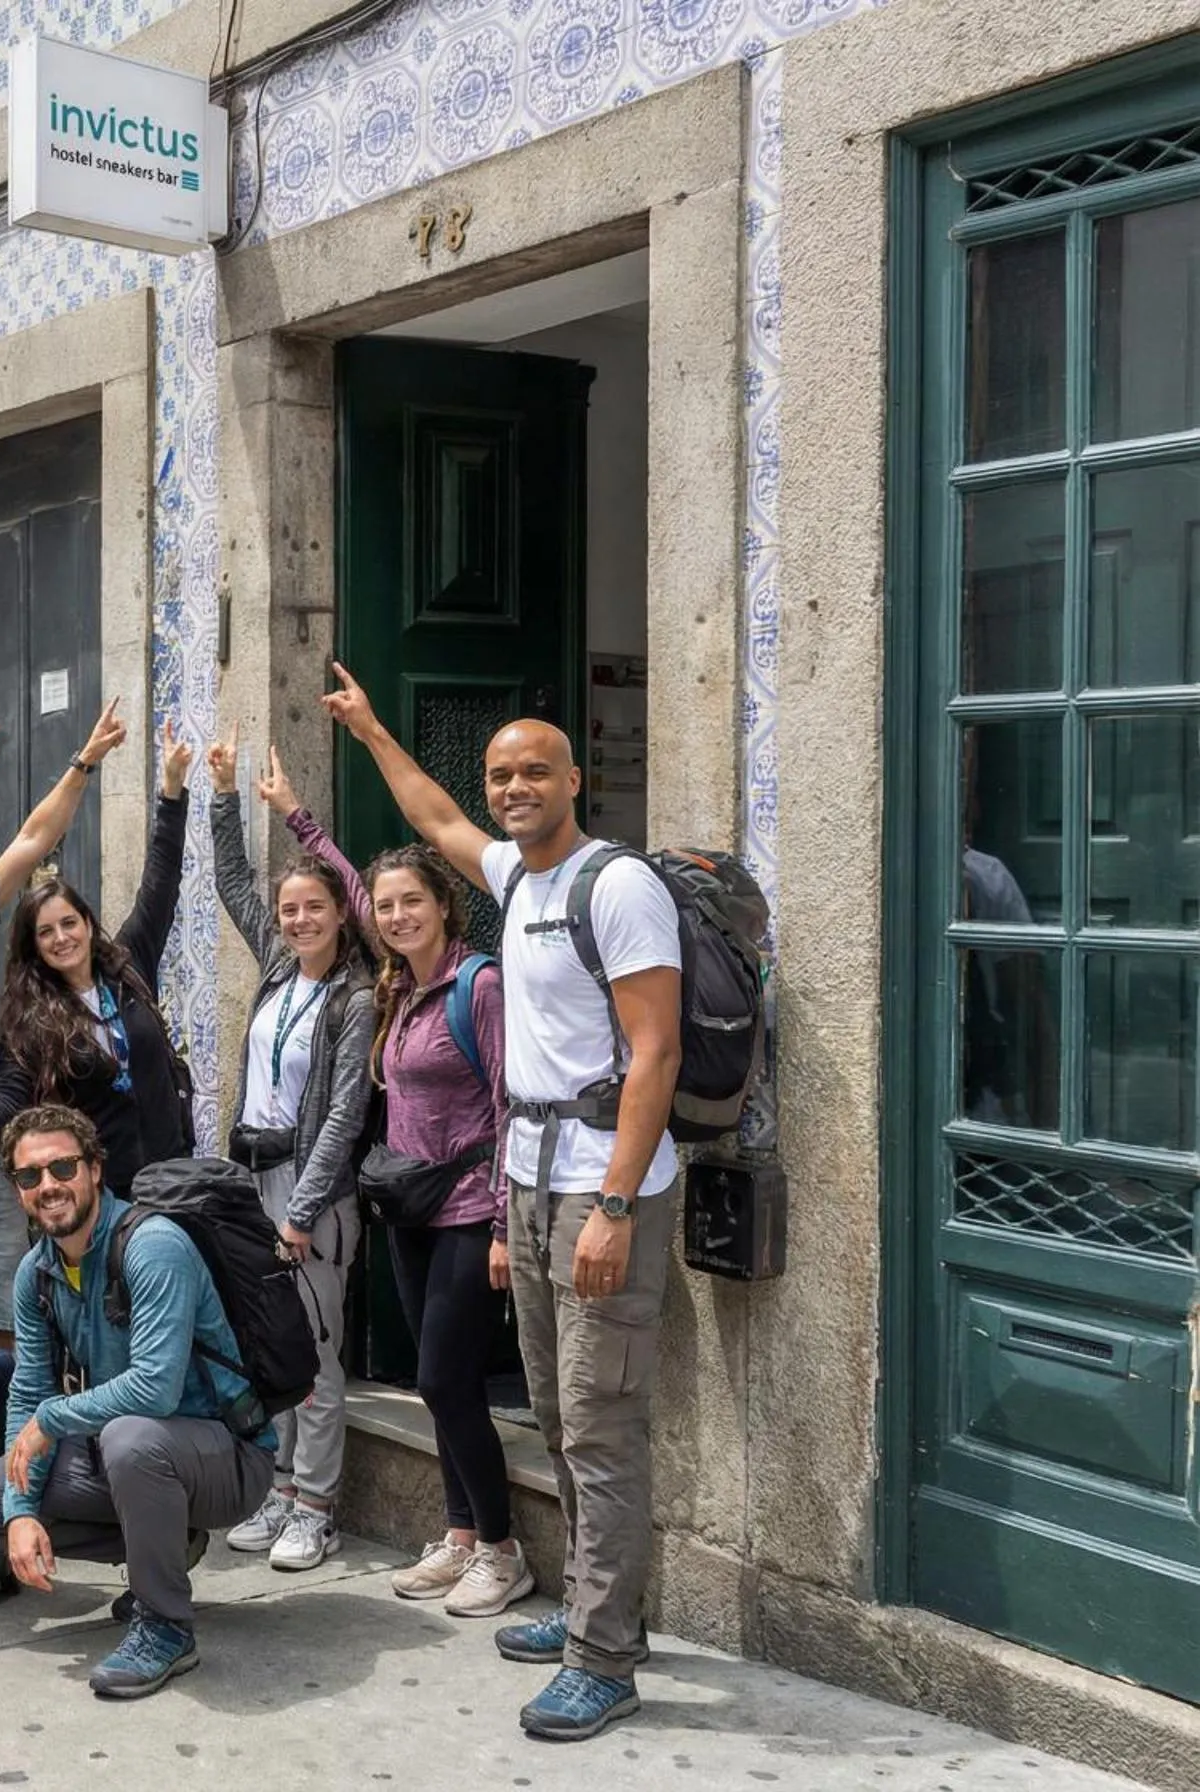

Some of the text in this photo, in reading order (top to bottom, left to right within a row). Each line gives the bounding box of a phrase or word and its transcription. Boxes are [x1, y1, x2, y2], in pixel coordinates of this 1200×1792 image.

[50, 92, 199, 162] invictus
[50, 143, 180, 186] hostel sneakers bar
